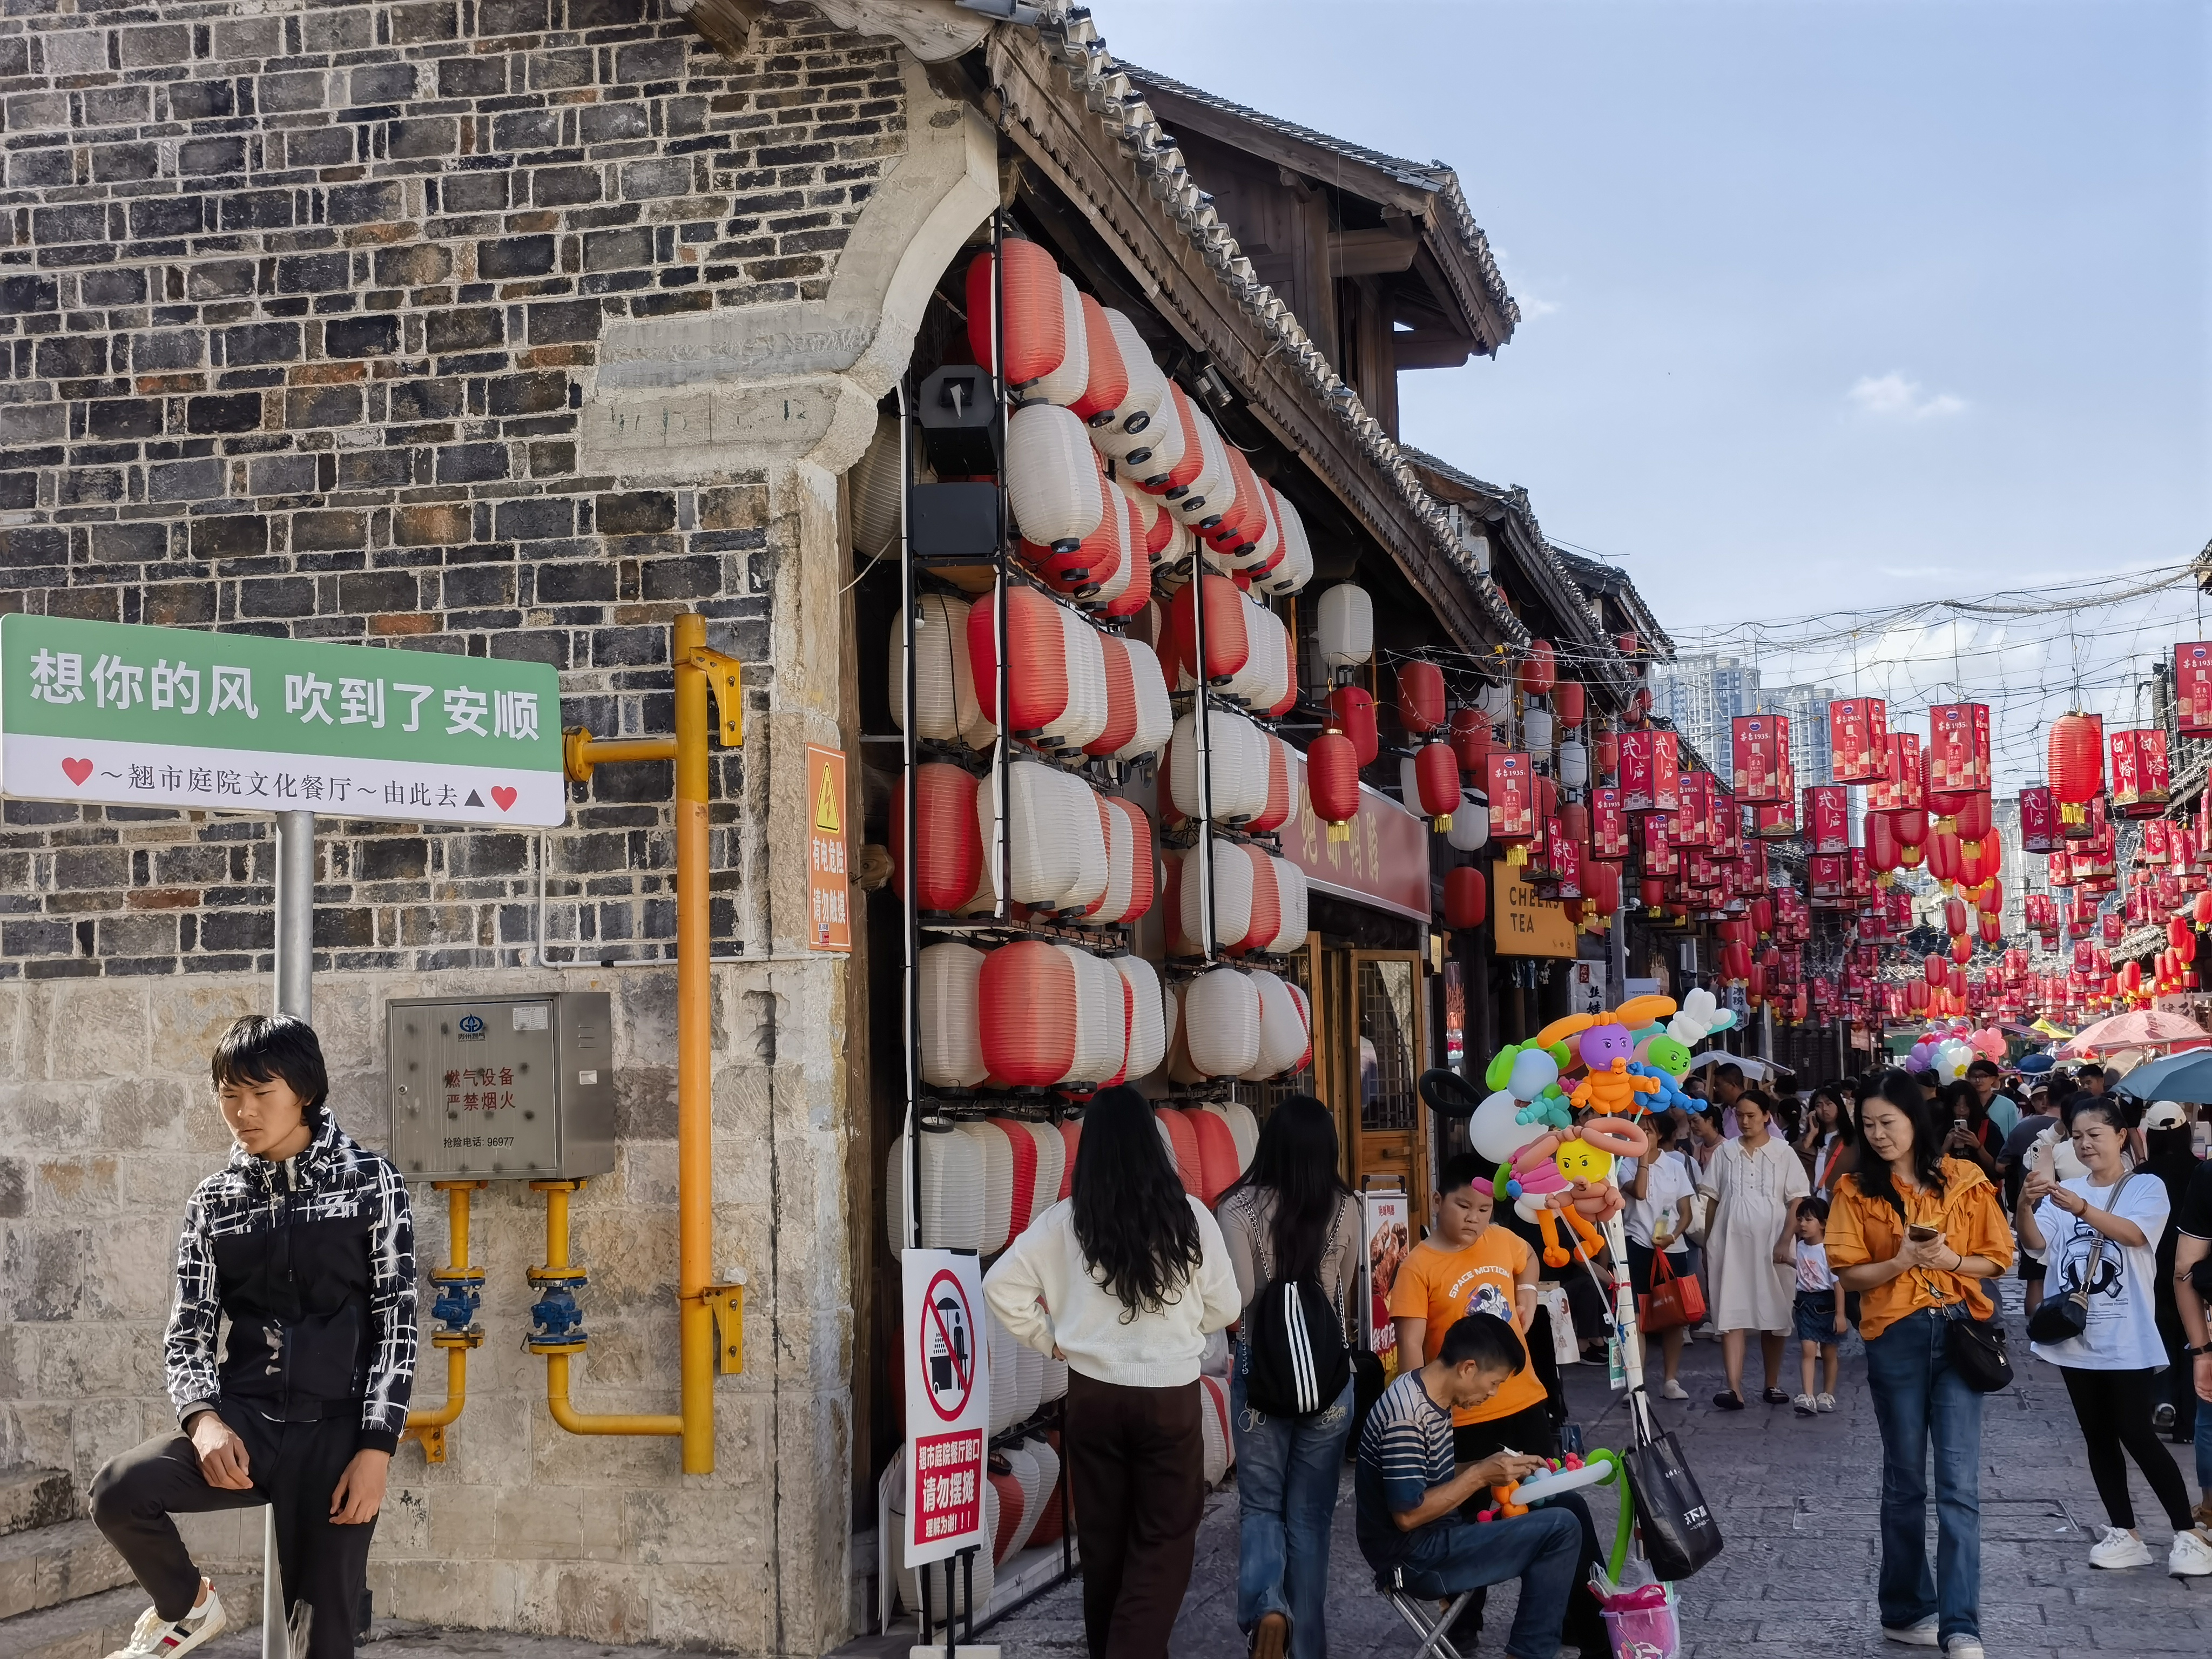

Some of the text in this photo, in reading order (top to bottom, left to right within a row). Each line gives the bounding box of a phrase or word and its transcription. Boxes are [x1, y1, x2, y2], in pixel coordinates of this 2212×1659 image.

[29, 648, 541, 740] 想你的风 吹到了安顺
[1741, 732, 1769, 741] 茅台1935
[1495, 768, 1524, 778] 茅台1935
[2113, 738, 2135, 777] 白塔
[2139, 735, 2167, 777] 白塔
[812, 836, 845, 874] 有电危险
[813, 887, 846, 925] 请勿触摸
[1510, 913, 1535, 933] TEA
[445, 1067, 514, 1089] 燃气设备
[445, 1091, 516, 1112] 严禁烟火
[443, 1136, 514, 1148] 抢险电话: 96977
[1448, 1265, 1510, 1299] SPACE MOTION
[922, 1469, 975, 1513] 请勿摆摊
